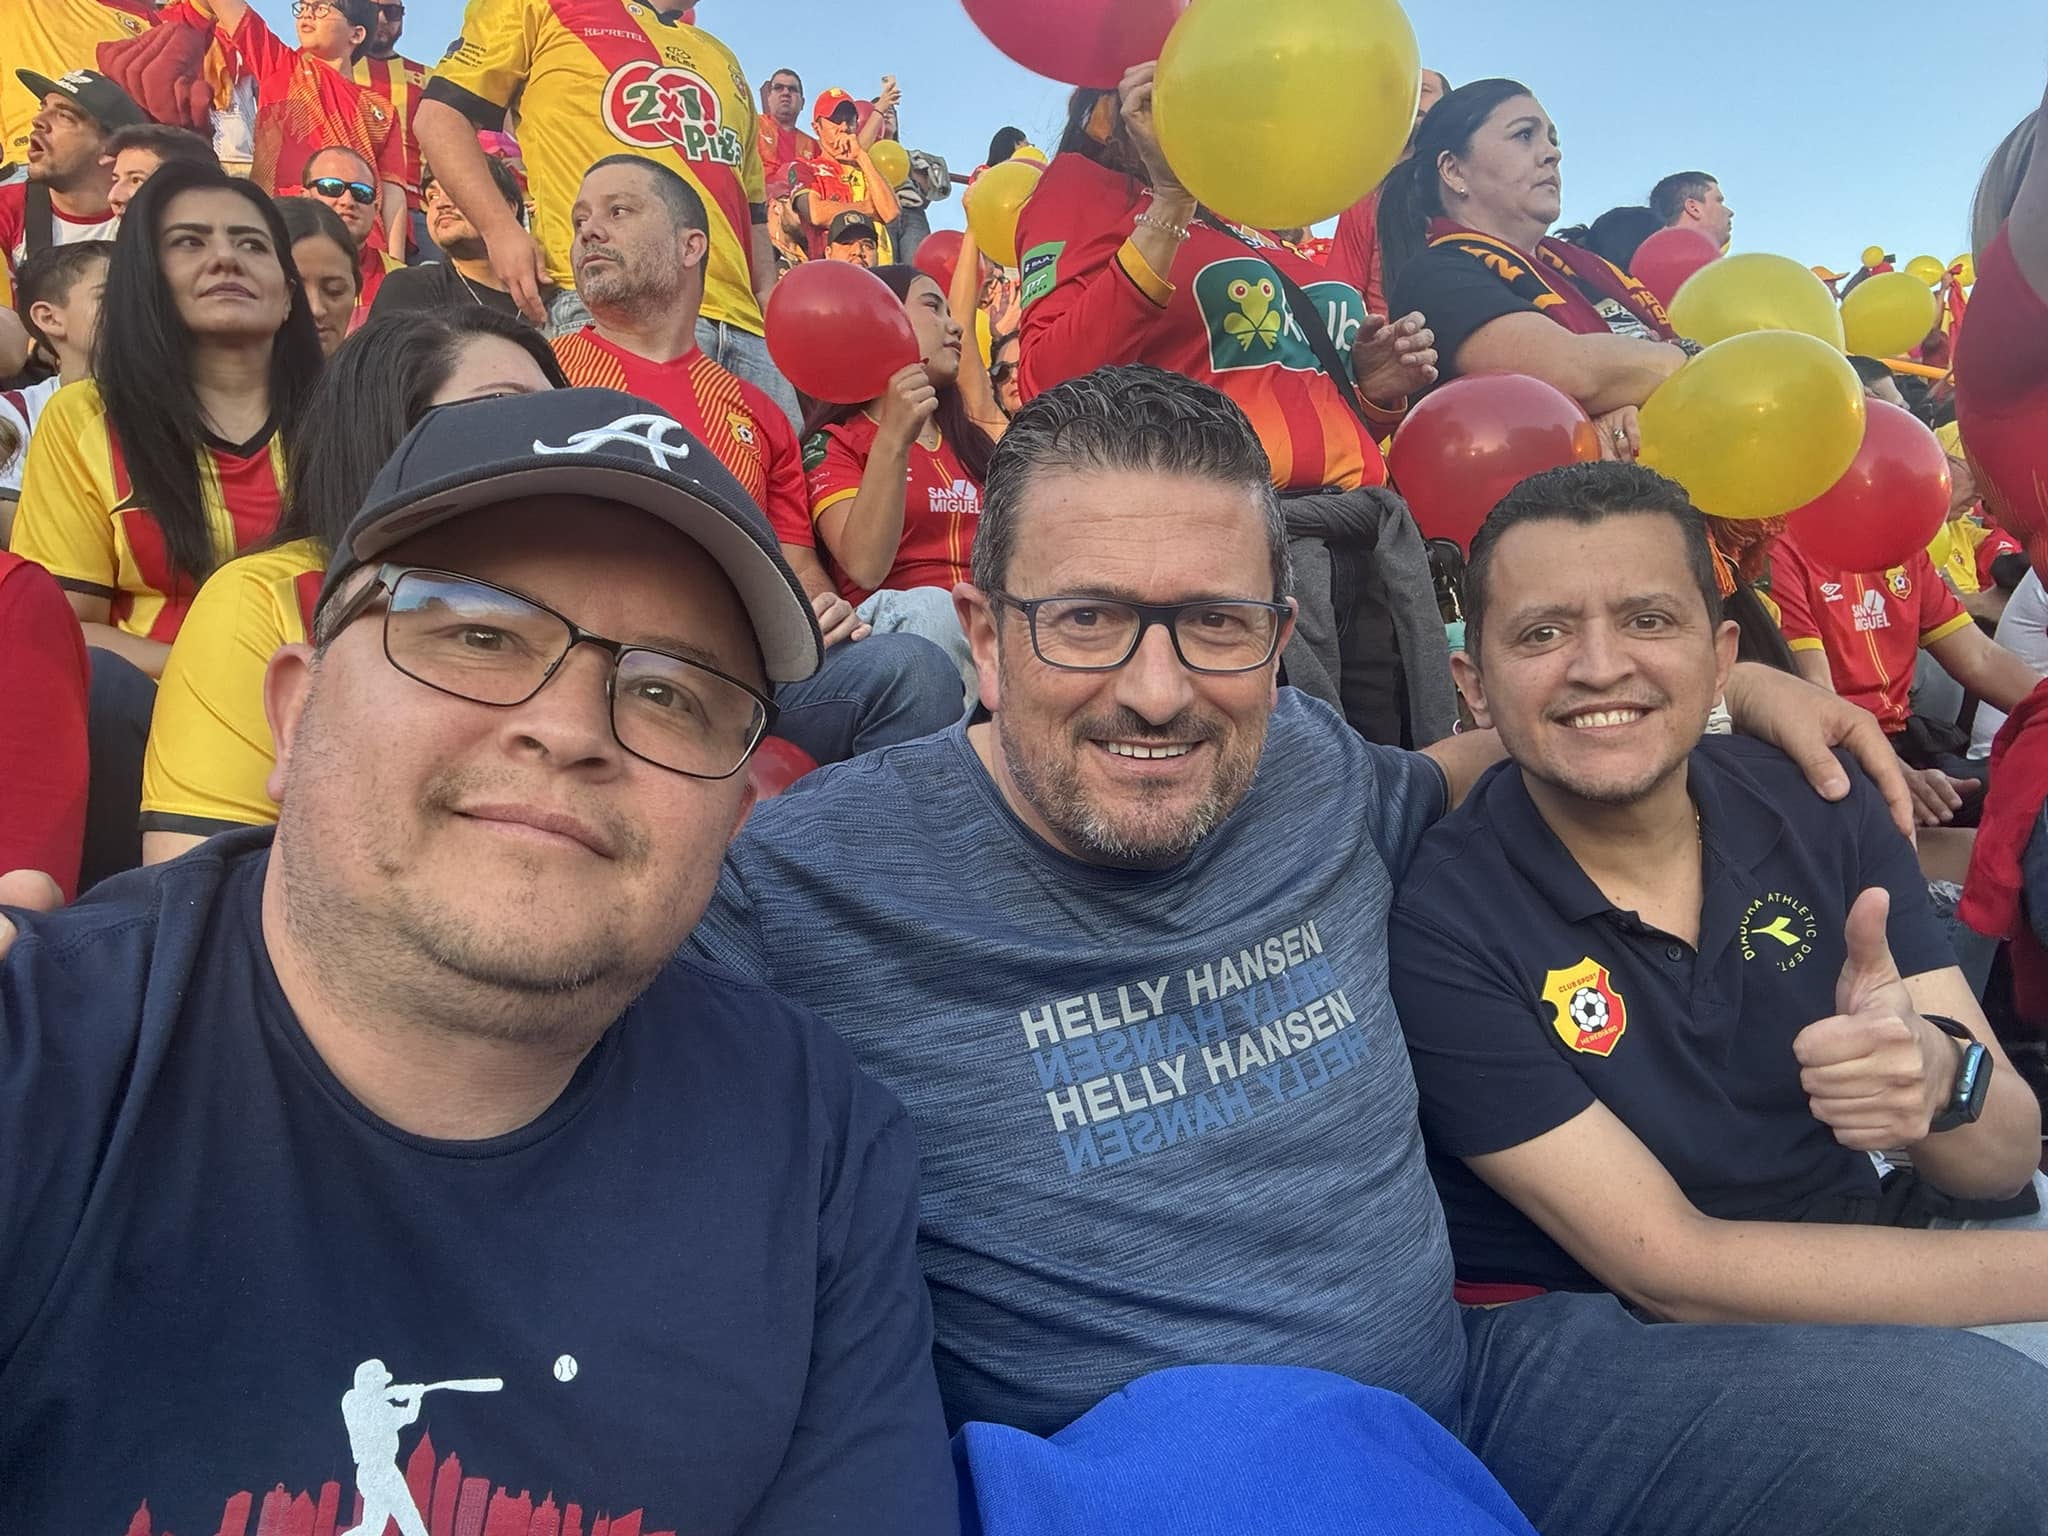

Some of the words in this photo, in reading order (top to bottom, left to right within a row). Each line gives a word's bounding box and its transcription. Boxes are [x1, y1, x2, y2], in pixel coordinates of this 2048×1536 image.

[664, 52, 698, 70] KELME
[929, 498, 982, 515] MIGUEL
[1767, 892, 1817, 938] ATHLETIC
[1776, 944, 1812, 972] DEPT.
[1019, 975, 1170, 1049] HELLY
[1186, 920, 1324, 1005] HANSEN
[1558, 981, 1577, 993] CLUB
[1577, 973, 1597, 986] SPORT
[1580, 1024, 1618, 1046] HEREDIANO
[1046, 1054, 1187, 1132] HELLY
[1201, 990, 1357, 1085] HANSEN
